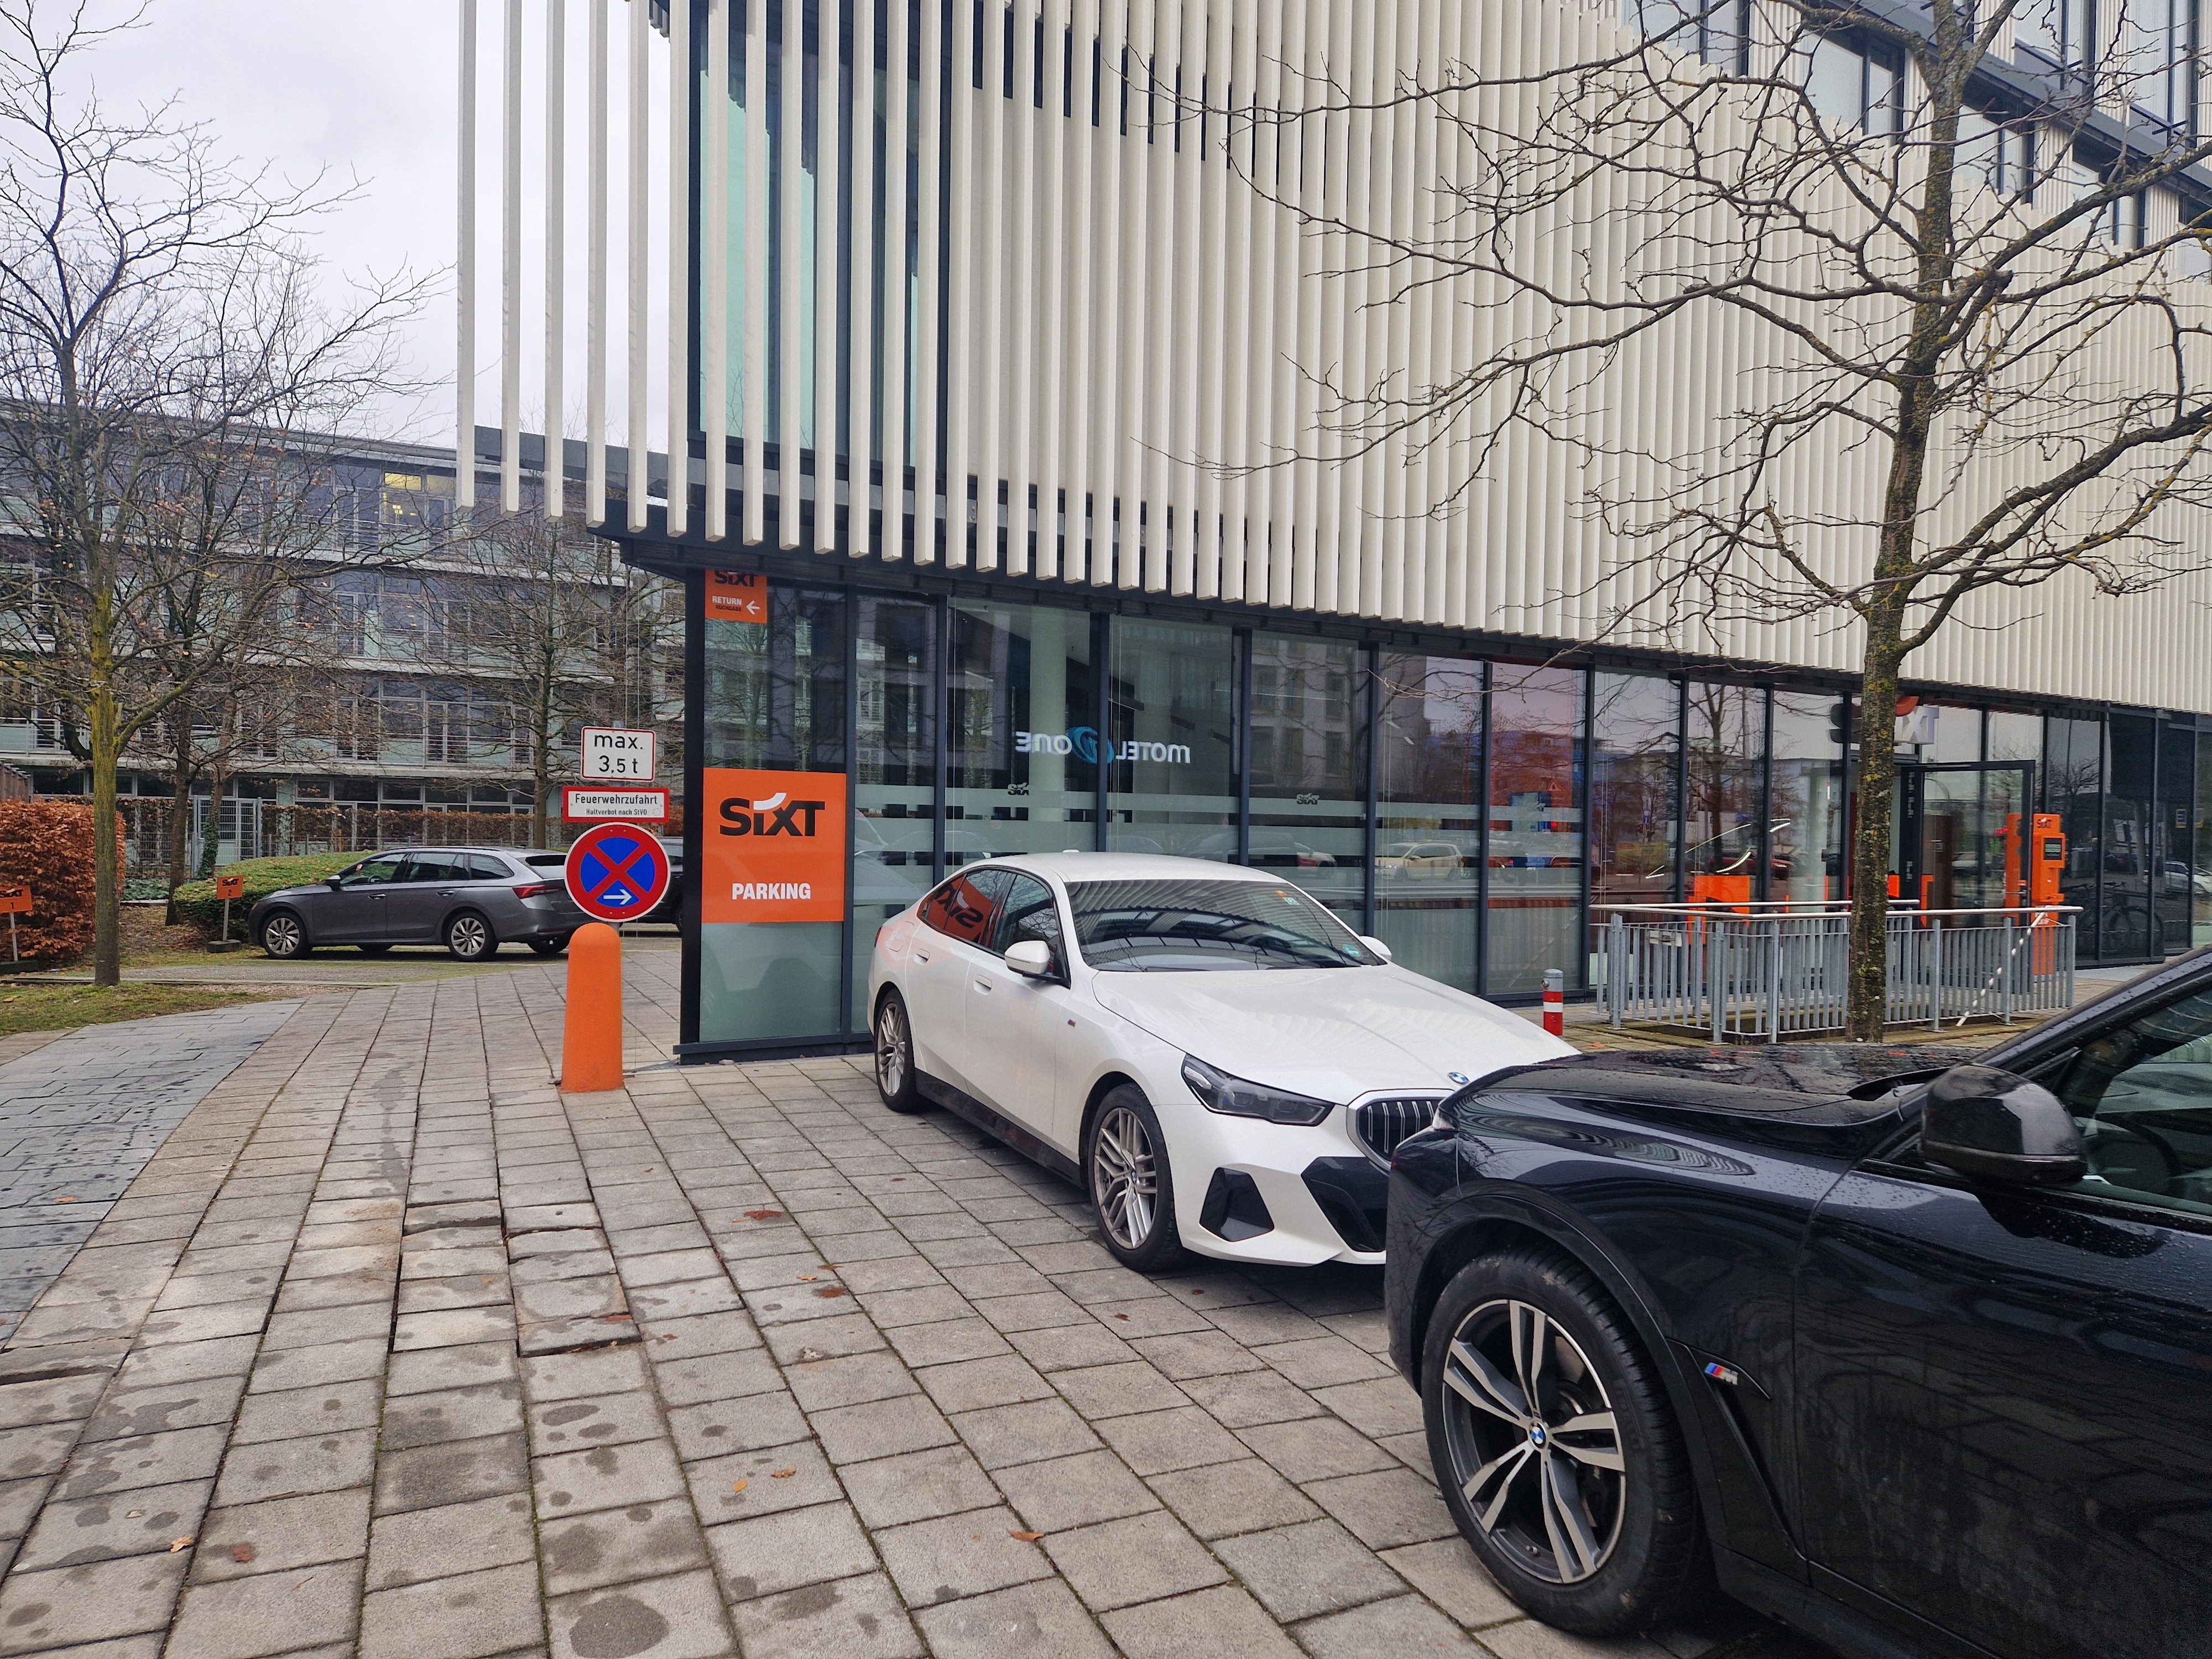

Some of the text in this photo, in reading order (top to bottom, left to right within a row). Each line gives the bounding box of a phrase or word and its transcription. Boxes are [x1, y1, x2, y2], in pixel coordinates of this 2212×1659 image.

[712, 596, 742, 606] RETURN
[594, 734, 643, 750] max.
[598, 755, 638, 774] 3,5 t
[575, 793, 658, 805] Feuerwehrzufahrt
[719, 792, 826, 837] SIXT
[732, 883, 811, 900] PARKING
